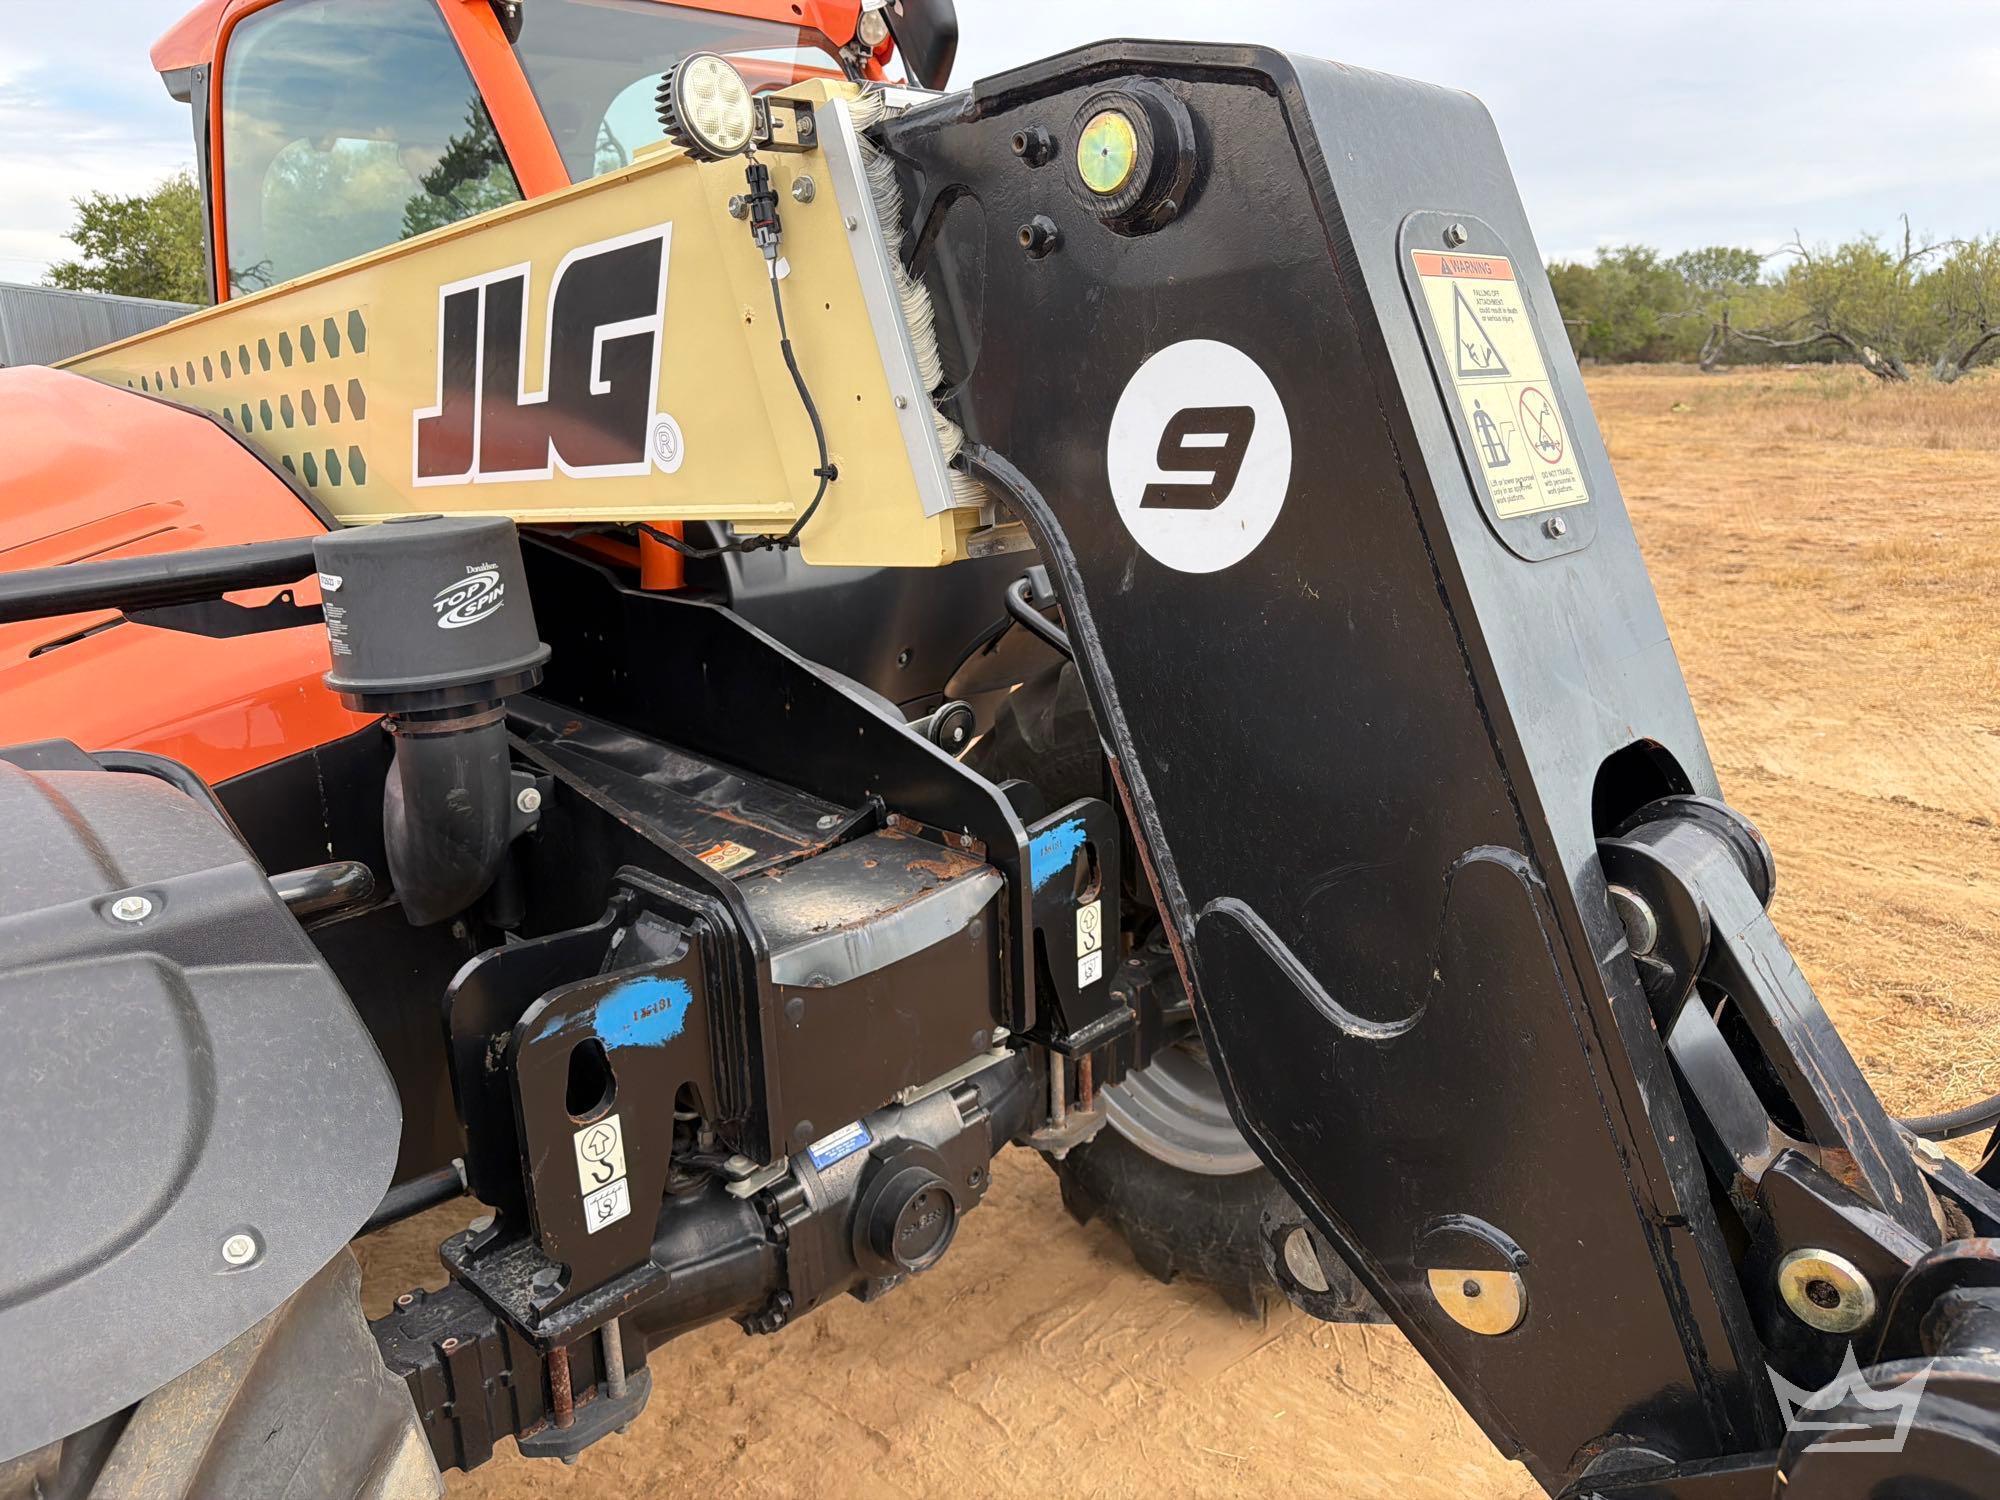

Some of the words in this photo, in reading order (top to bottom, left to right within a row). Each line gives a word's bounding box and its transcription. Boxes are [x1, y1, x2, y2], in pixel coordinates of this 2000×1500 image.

[1450, 259, 1492, 274] WARNING
[1473, 289, 1491, 297] FALLING
[412, 221, 672, 487] JLG
[1139, 405, 1255, 510] 9
[1541, 471, 1549, 479] DO
[432, 583, 480, 613] TOP
[464, 583, 505, 616] SPIN
